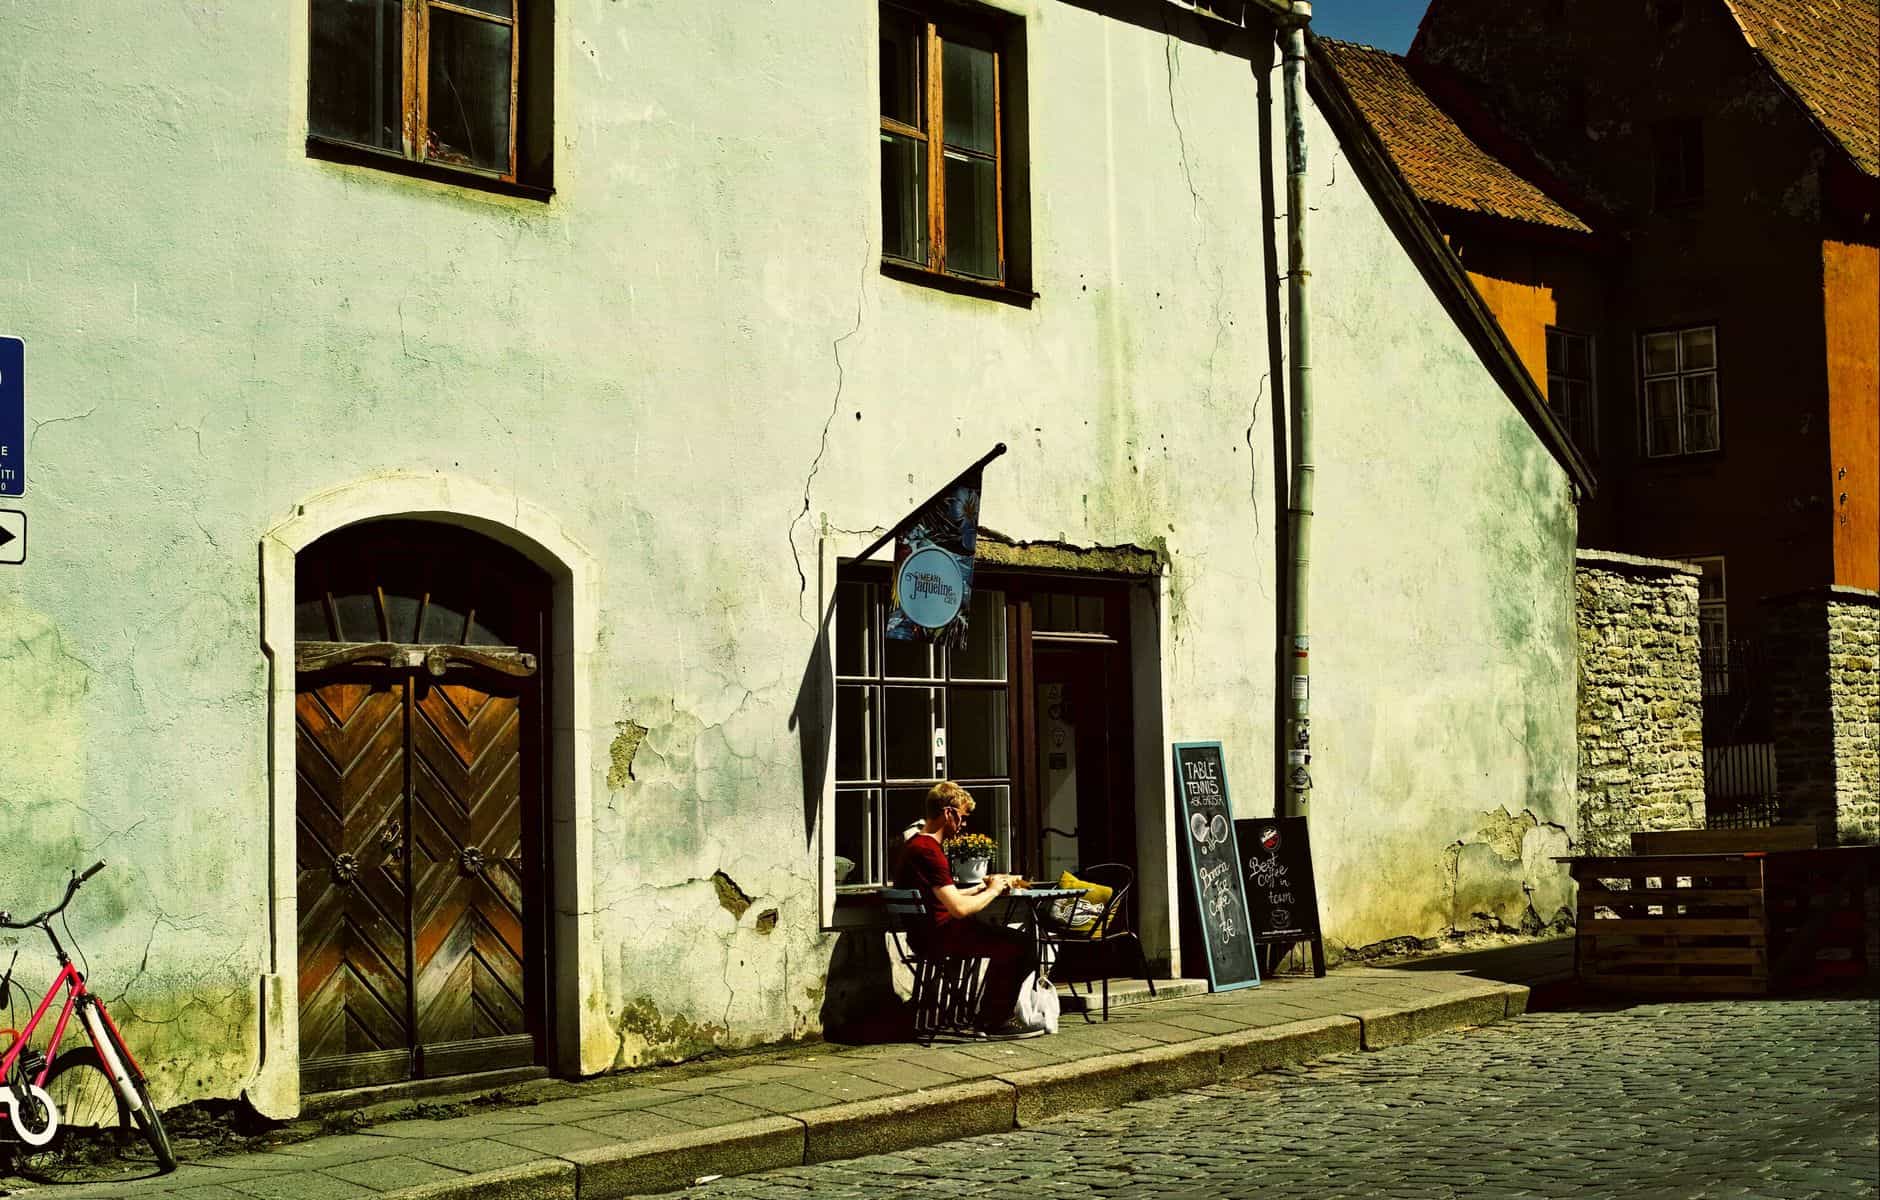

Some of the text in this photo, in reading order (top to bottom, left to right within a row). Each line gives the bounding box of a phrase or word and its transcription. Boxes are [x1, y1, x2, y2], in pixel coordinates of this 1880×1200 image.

[1185, 761, 1217, 780] TABLE
[1186, 780, 1219, 795] TENNIS
[1249, 852, 1279, 880] Best
